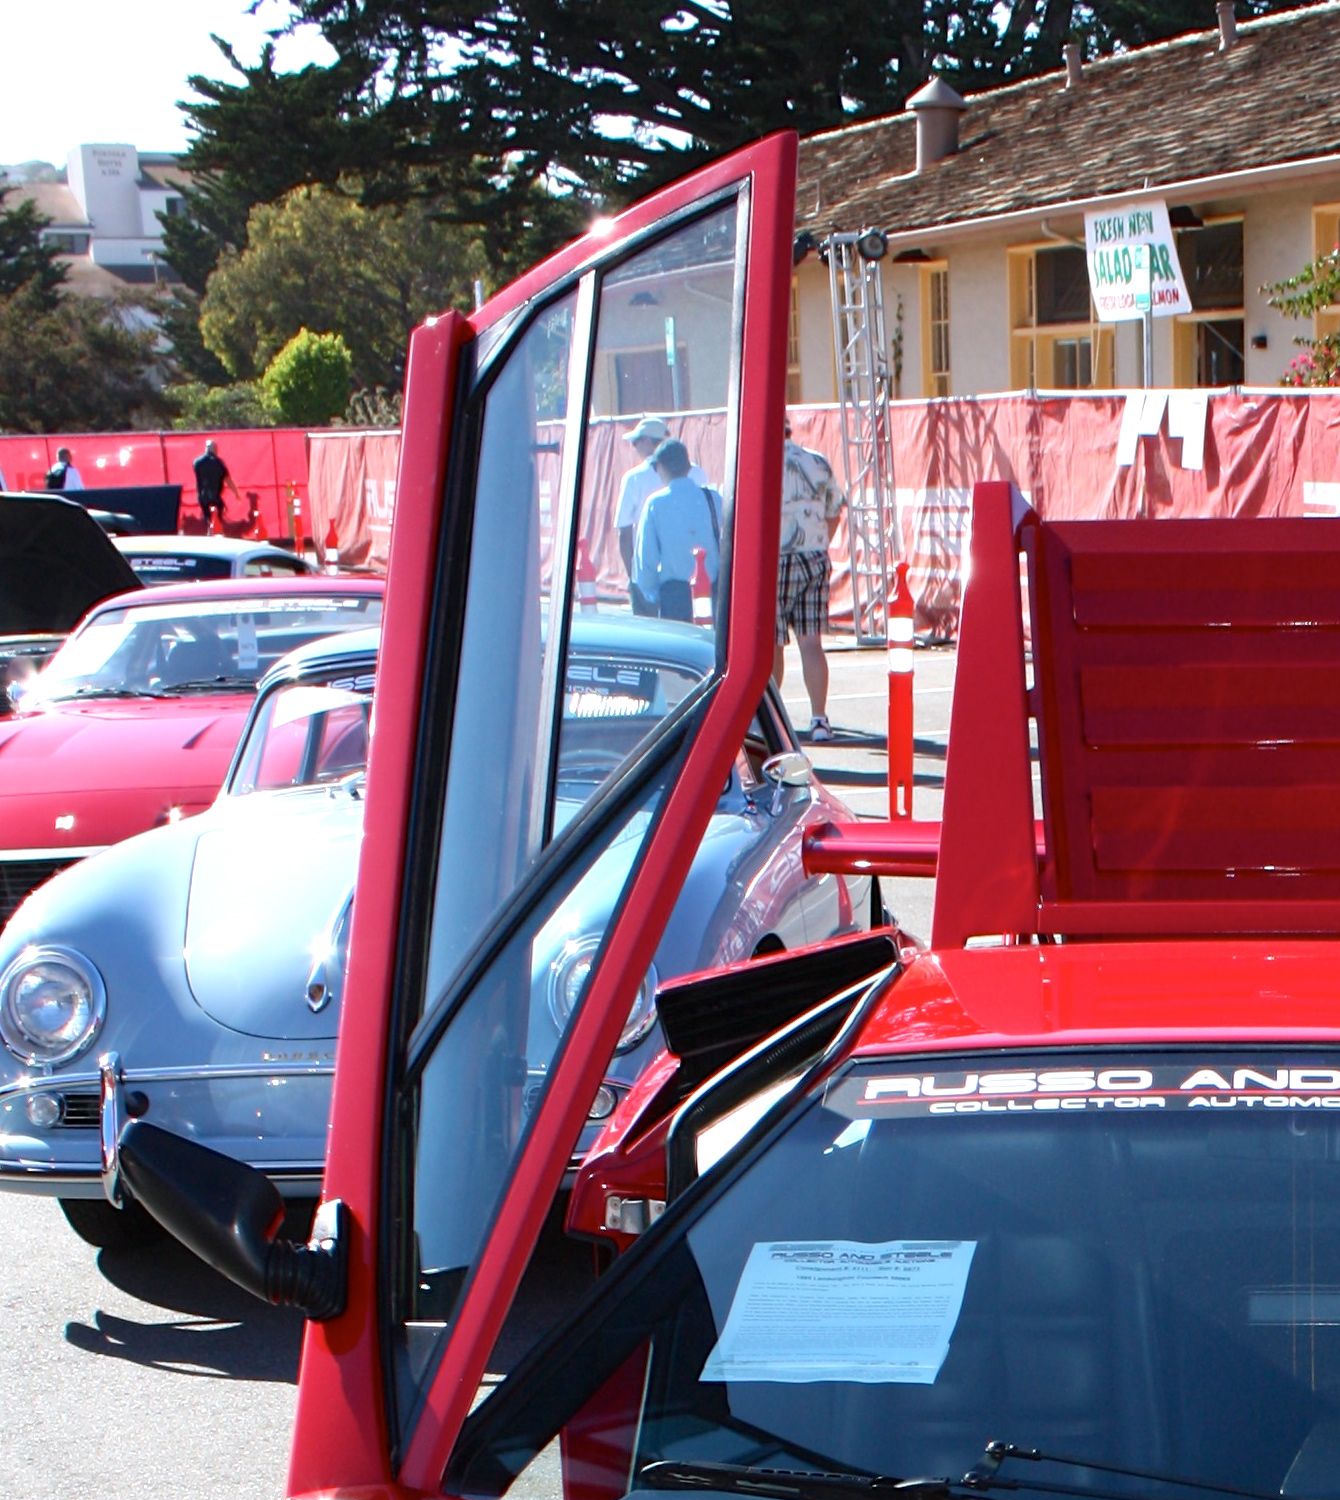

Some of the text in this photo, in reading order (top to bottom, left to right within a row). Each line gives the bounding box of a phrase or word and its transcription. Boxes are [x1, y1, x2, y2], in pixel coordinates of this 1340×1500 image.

[1094, 211, 1154, 243] FRESH NEW
[1094, 244, 1176, 288] SALAD AR
[1152, 288, 1179, 306] LMON
[130, 558, 196, 567] STEELE
[567, 665, 640, 686] ELE
[864, 1069, 1153, 1099] RUSSO
[929, 1096, 1166, 1113] COLLECTOR
[771, 1251, 953, 1260] RUSSO AND STEELE
